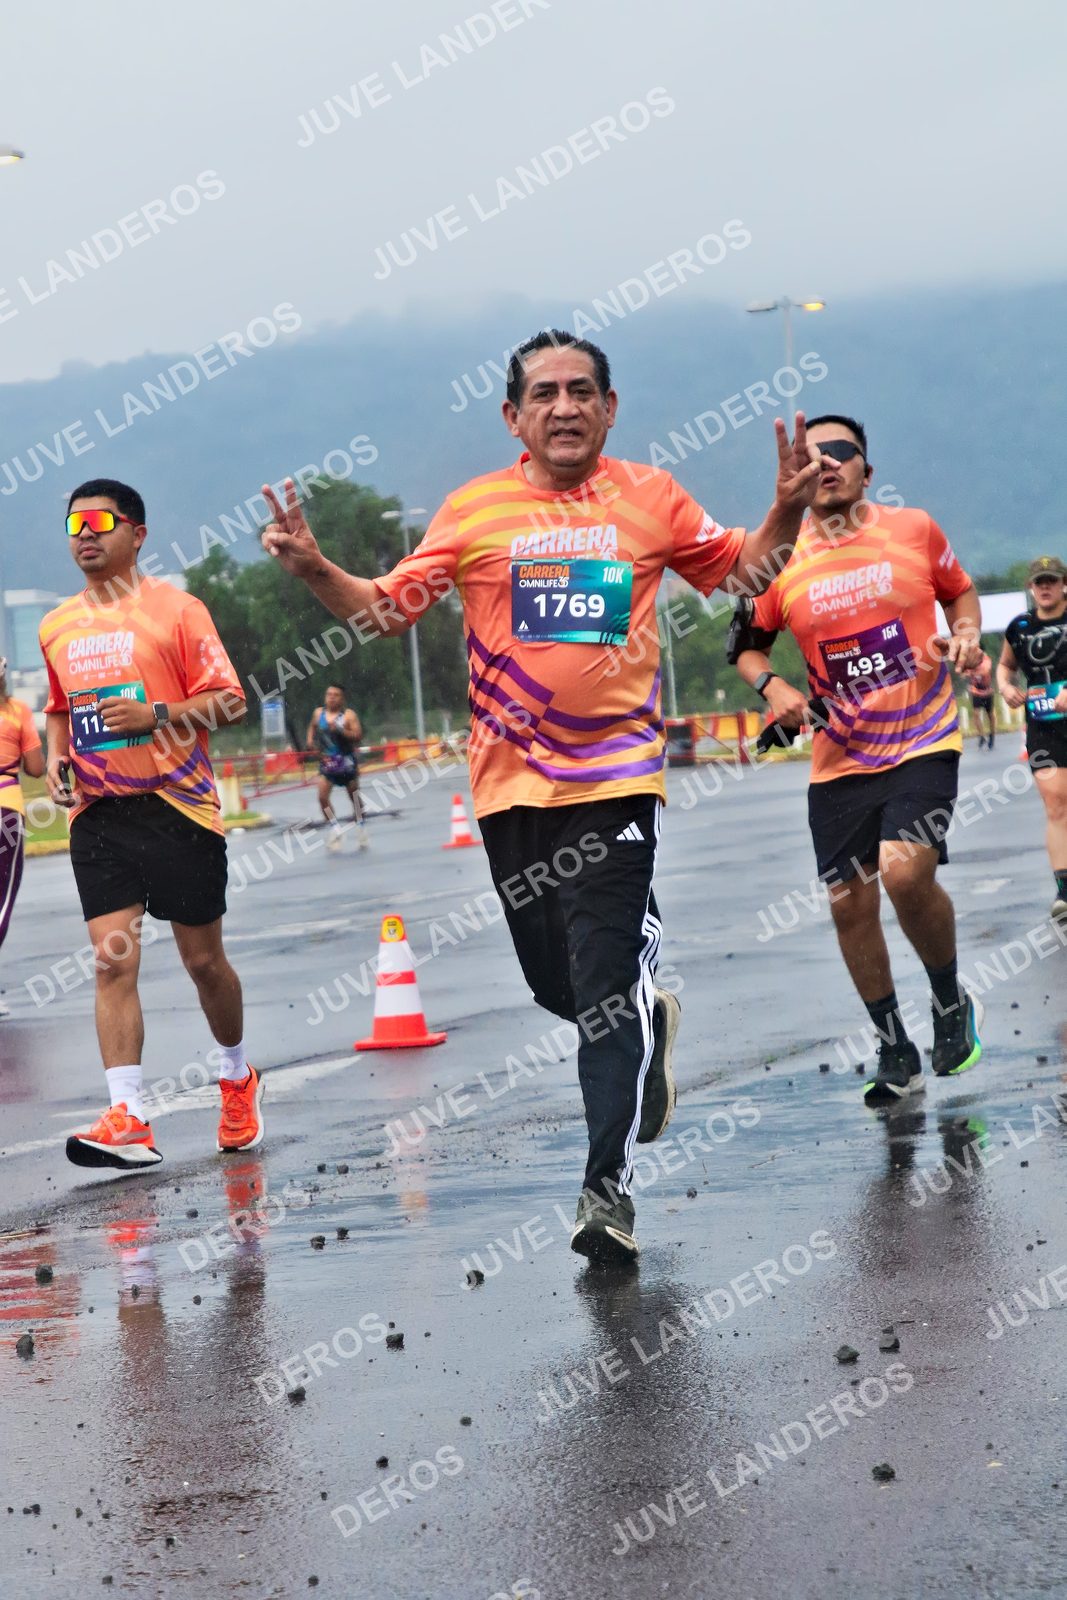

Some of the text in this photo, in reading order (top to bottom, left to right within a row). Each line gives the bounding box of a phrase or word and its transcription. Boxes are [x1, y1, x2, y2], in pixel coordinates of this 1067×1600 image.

[511, 524, 617, 557] CARRERA
[519, 565, 570, 579] CARRERA
[602, 566, 624, 584] 10K
[808, 561, 893, 602] CARRERA
[533, 593, 605, 618] 1769
[811, 588, 875, 615] OMNILIFE
[68, 631, 134, 660] CARRERA
[825, 639, 860, 654] CARRERA
[69, 654, 119, 675] OMNILIFE
[847, 652, 887, 677] 493
[120, 687, 138, 699] 10K
